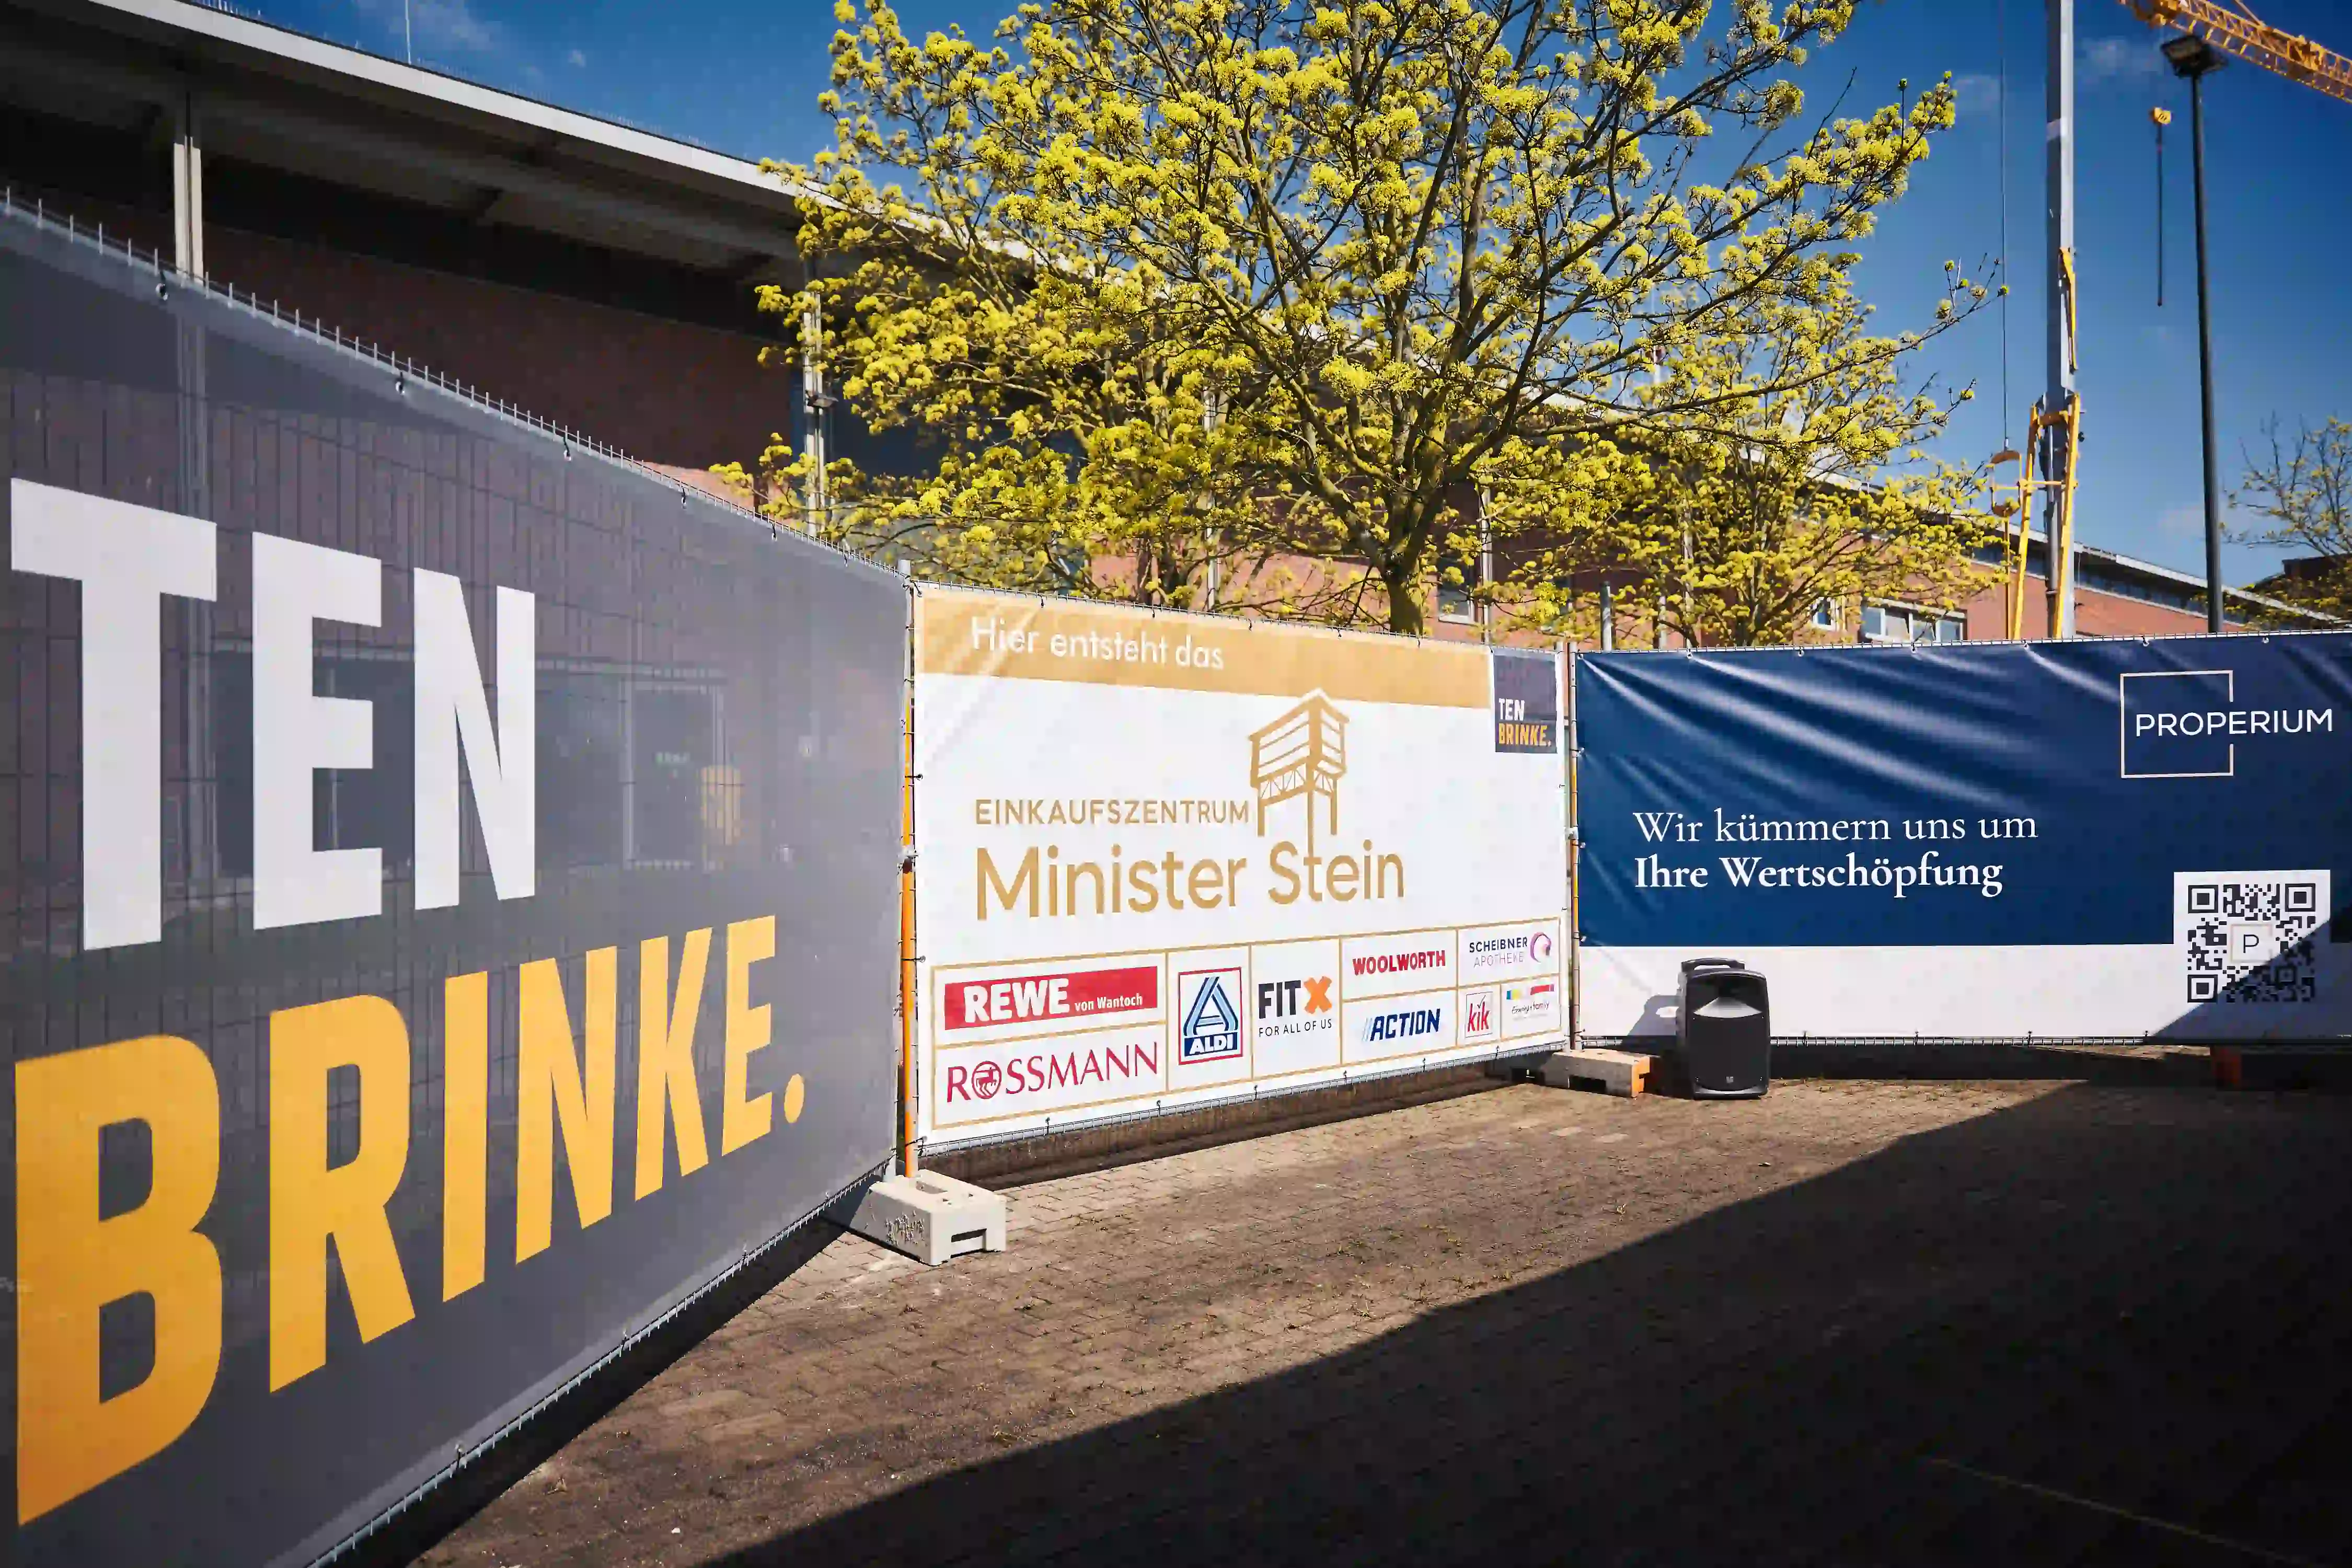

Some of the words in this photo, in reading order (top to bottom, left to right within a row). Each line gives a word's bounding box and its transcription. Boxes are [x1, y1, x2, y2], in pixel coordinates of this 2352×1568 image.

[971, 616, 1038, 653] Hier
[1050, 630, 1169, 664] entsteht
[1175, 636, 1224, 670] das
[11, 477, 535, 950] TEN
[1498, 698, 1525, 721] TEN
[2136, 709, 2333, 737] PROPERIUM
[1498, 723, 1552, 747] BRINKE.
[975, 799, 1250, 825] EINKAUFSZENTRUM
[1633, 811, 1702, 843] Wir
[1714, 808, 1892, 842] kümmern
[1903, 816, 1966, 840] uns
[1977, 815, 2039, 839] um
[976, 844, 1247, 920] Minister
[1267, 839, 1404, 905] Stein
[1634, 854, 1709, 888] Ihre
[1719, 851, 2003, 898] Wertschöpfung
[1469, 936, 1528, 953] SCHEIBNER
[2243, 934, 2259, 953] P
[1353, 950, 1446, 976] WOOLWORTH
[963, 978, 1070, 1023] REWE
[1075, 1000, 1094, 1012] von
[1097, 993, 1143, 1009] Wantoch
[1258, 975, 1332, 1019] FITX
[1467, 995, 1491, 1033] kik
[1189, 1032, 1233, 1055] ALDI
[1259, 1024, 1279, 1037] FOR
[1283, 1022, 1301, 1035] ALL
[1304, 1020, 1317, 1031] OF
[1321, 1019, 1332, 1029] US
[947, 1041, 1158, 1103] ROSSMANN
[15, 915, 805, 1526] BRINKE.
